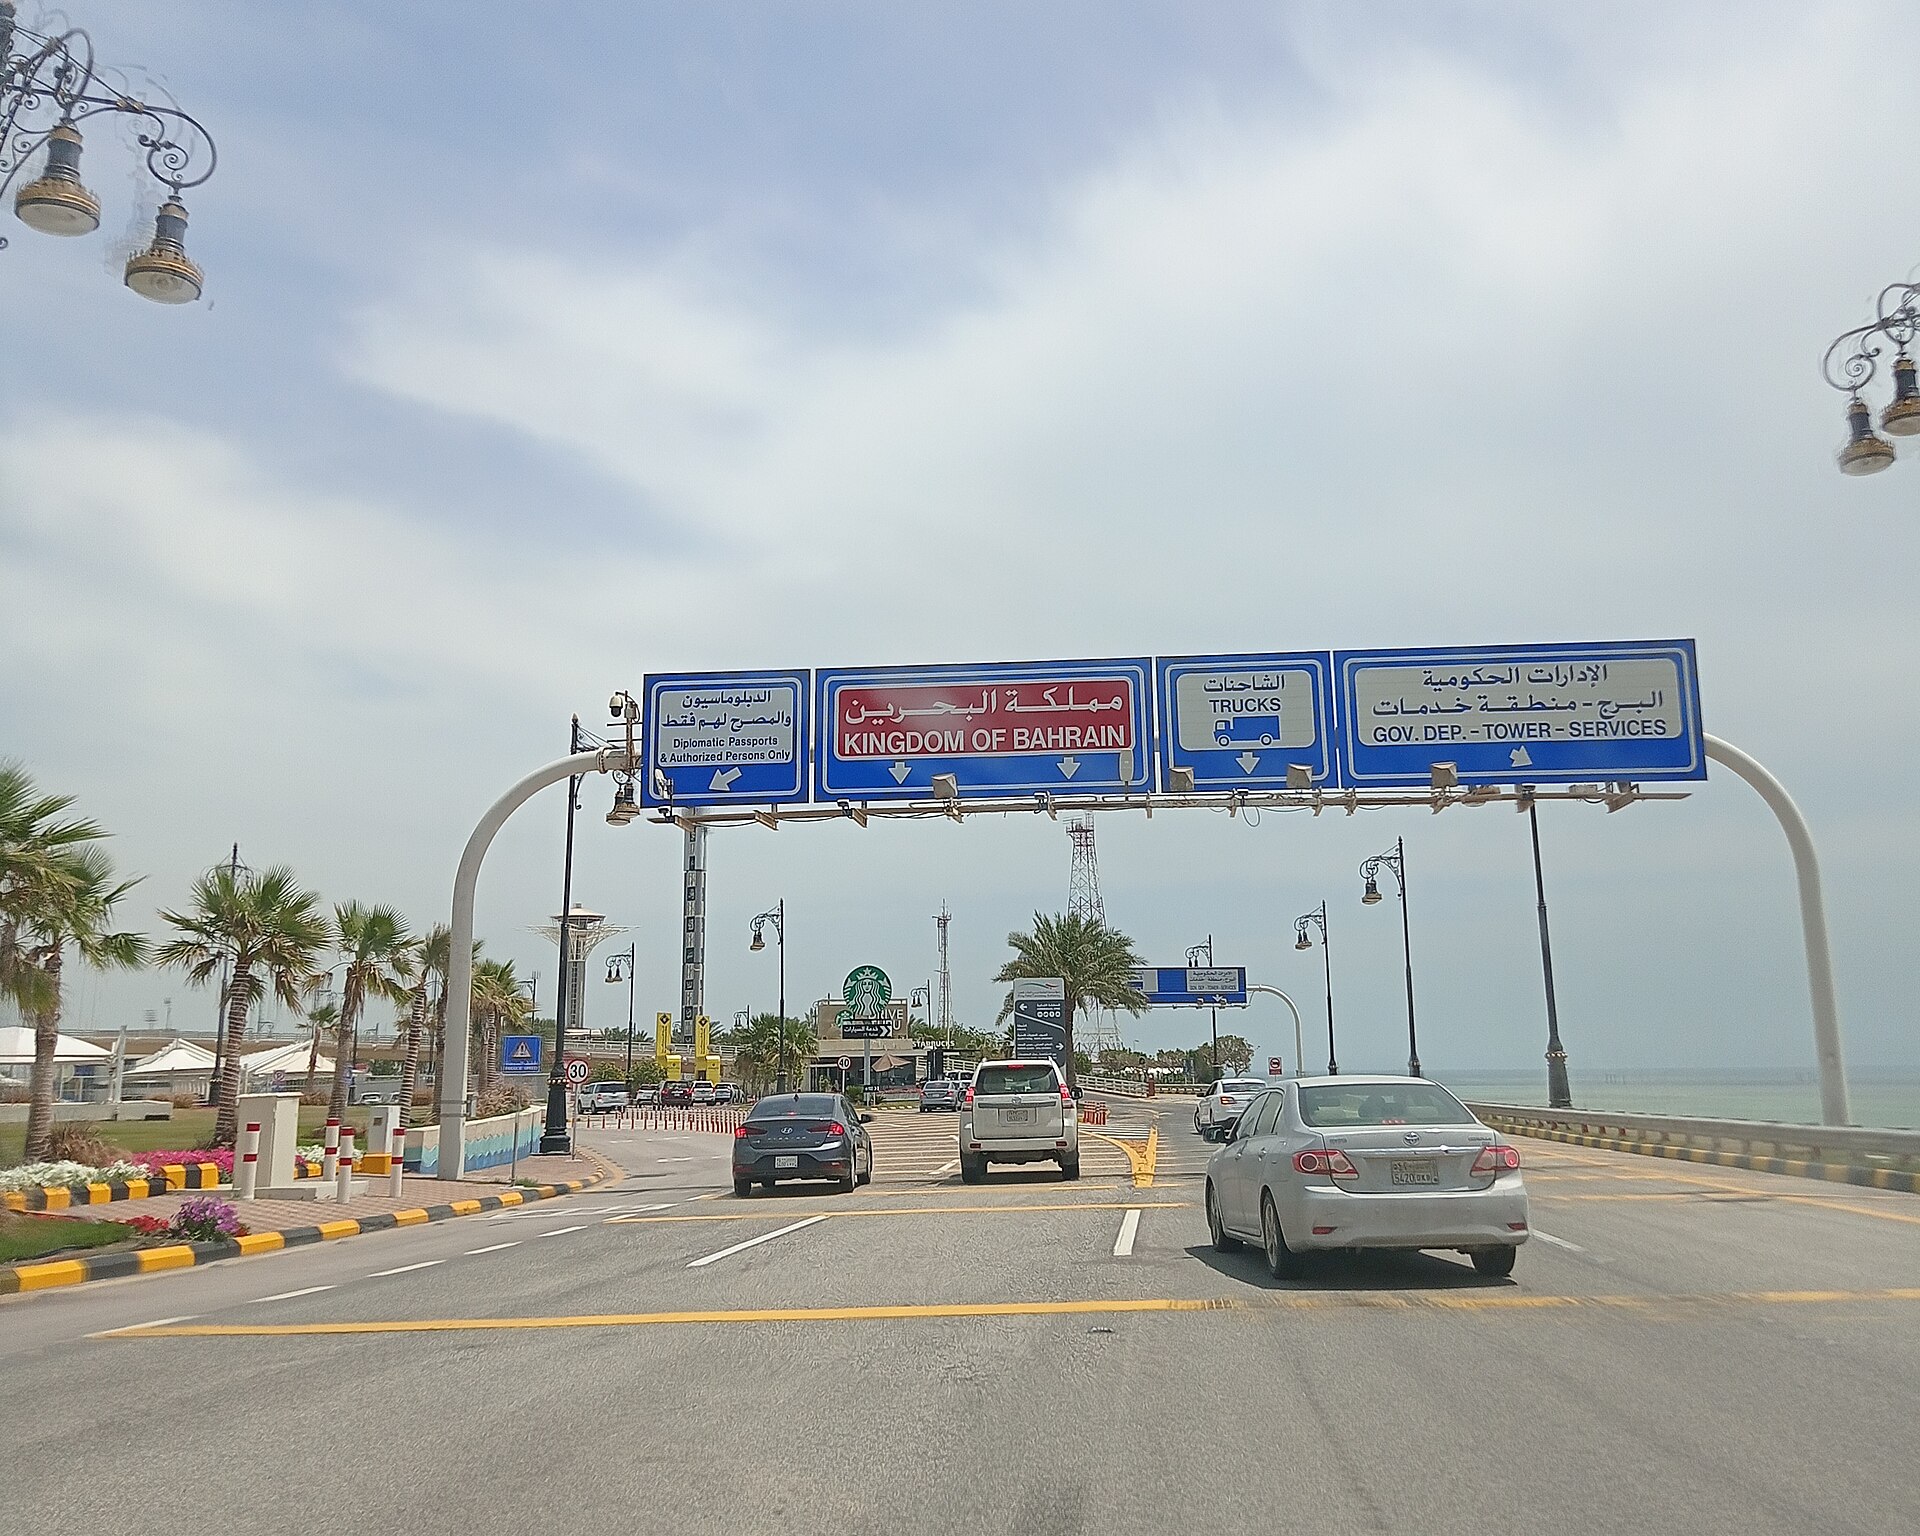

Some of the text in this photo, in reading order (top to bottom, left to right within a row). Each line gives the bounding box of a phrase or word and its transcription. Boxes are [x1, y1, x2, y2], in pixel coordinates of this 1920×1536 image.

[1203, 674, 1285, 692] الشاحنات
[1423, 663, 1608, 693] الإدارات الحكومية
[682, 690, 771, 709] الدبلوماسيون
[845, 686, 1123, 726] مملكة البحرين
[1209, 697, 1281, 714] TRUCKS
[1372, 697, 1473, 716] خدمات
[1479, 695, 1576, 714] منطقة
[1599, 691, 1663, 719] البرج
[661, 710, 791, 732] والمصرح لهم فقط
[844, 725, 1125, 755] KINGDOM OF BAHRAIN
[1372, 725, 1419, 743] GOV.
[1424, 724, 1467, 742] DEP.
[1482, 721, 1551, 740] TOWER
[1568, 719, 1667, 738] SERVICES
[673, 735, 778, 751] Diplomatic Passports
[660, 749, 791, 763] & Authorized Persons Only
[570, 1064, 586, 1078] 30
[839, 1058, 849, 1067] 40
